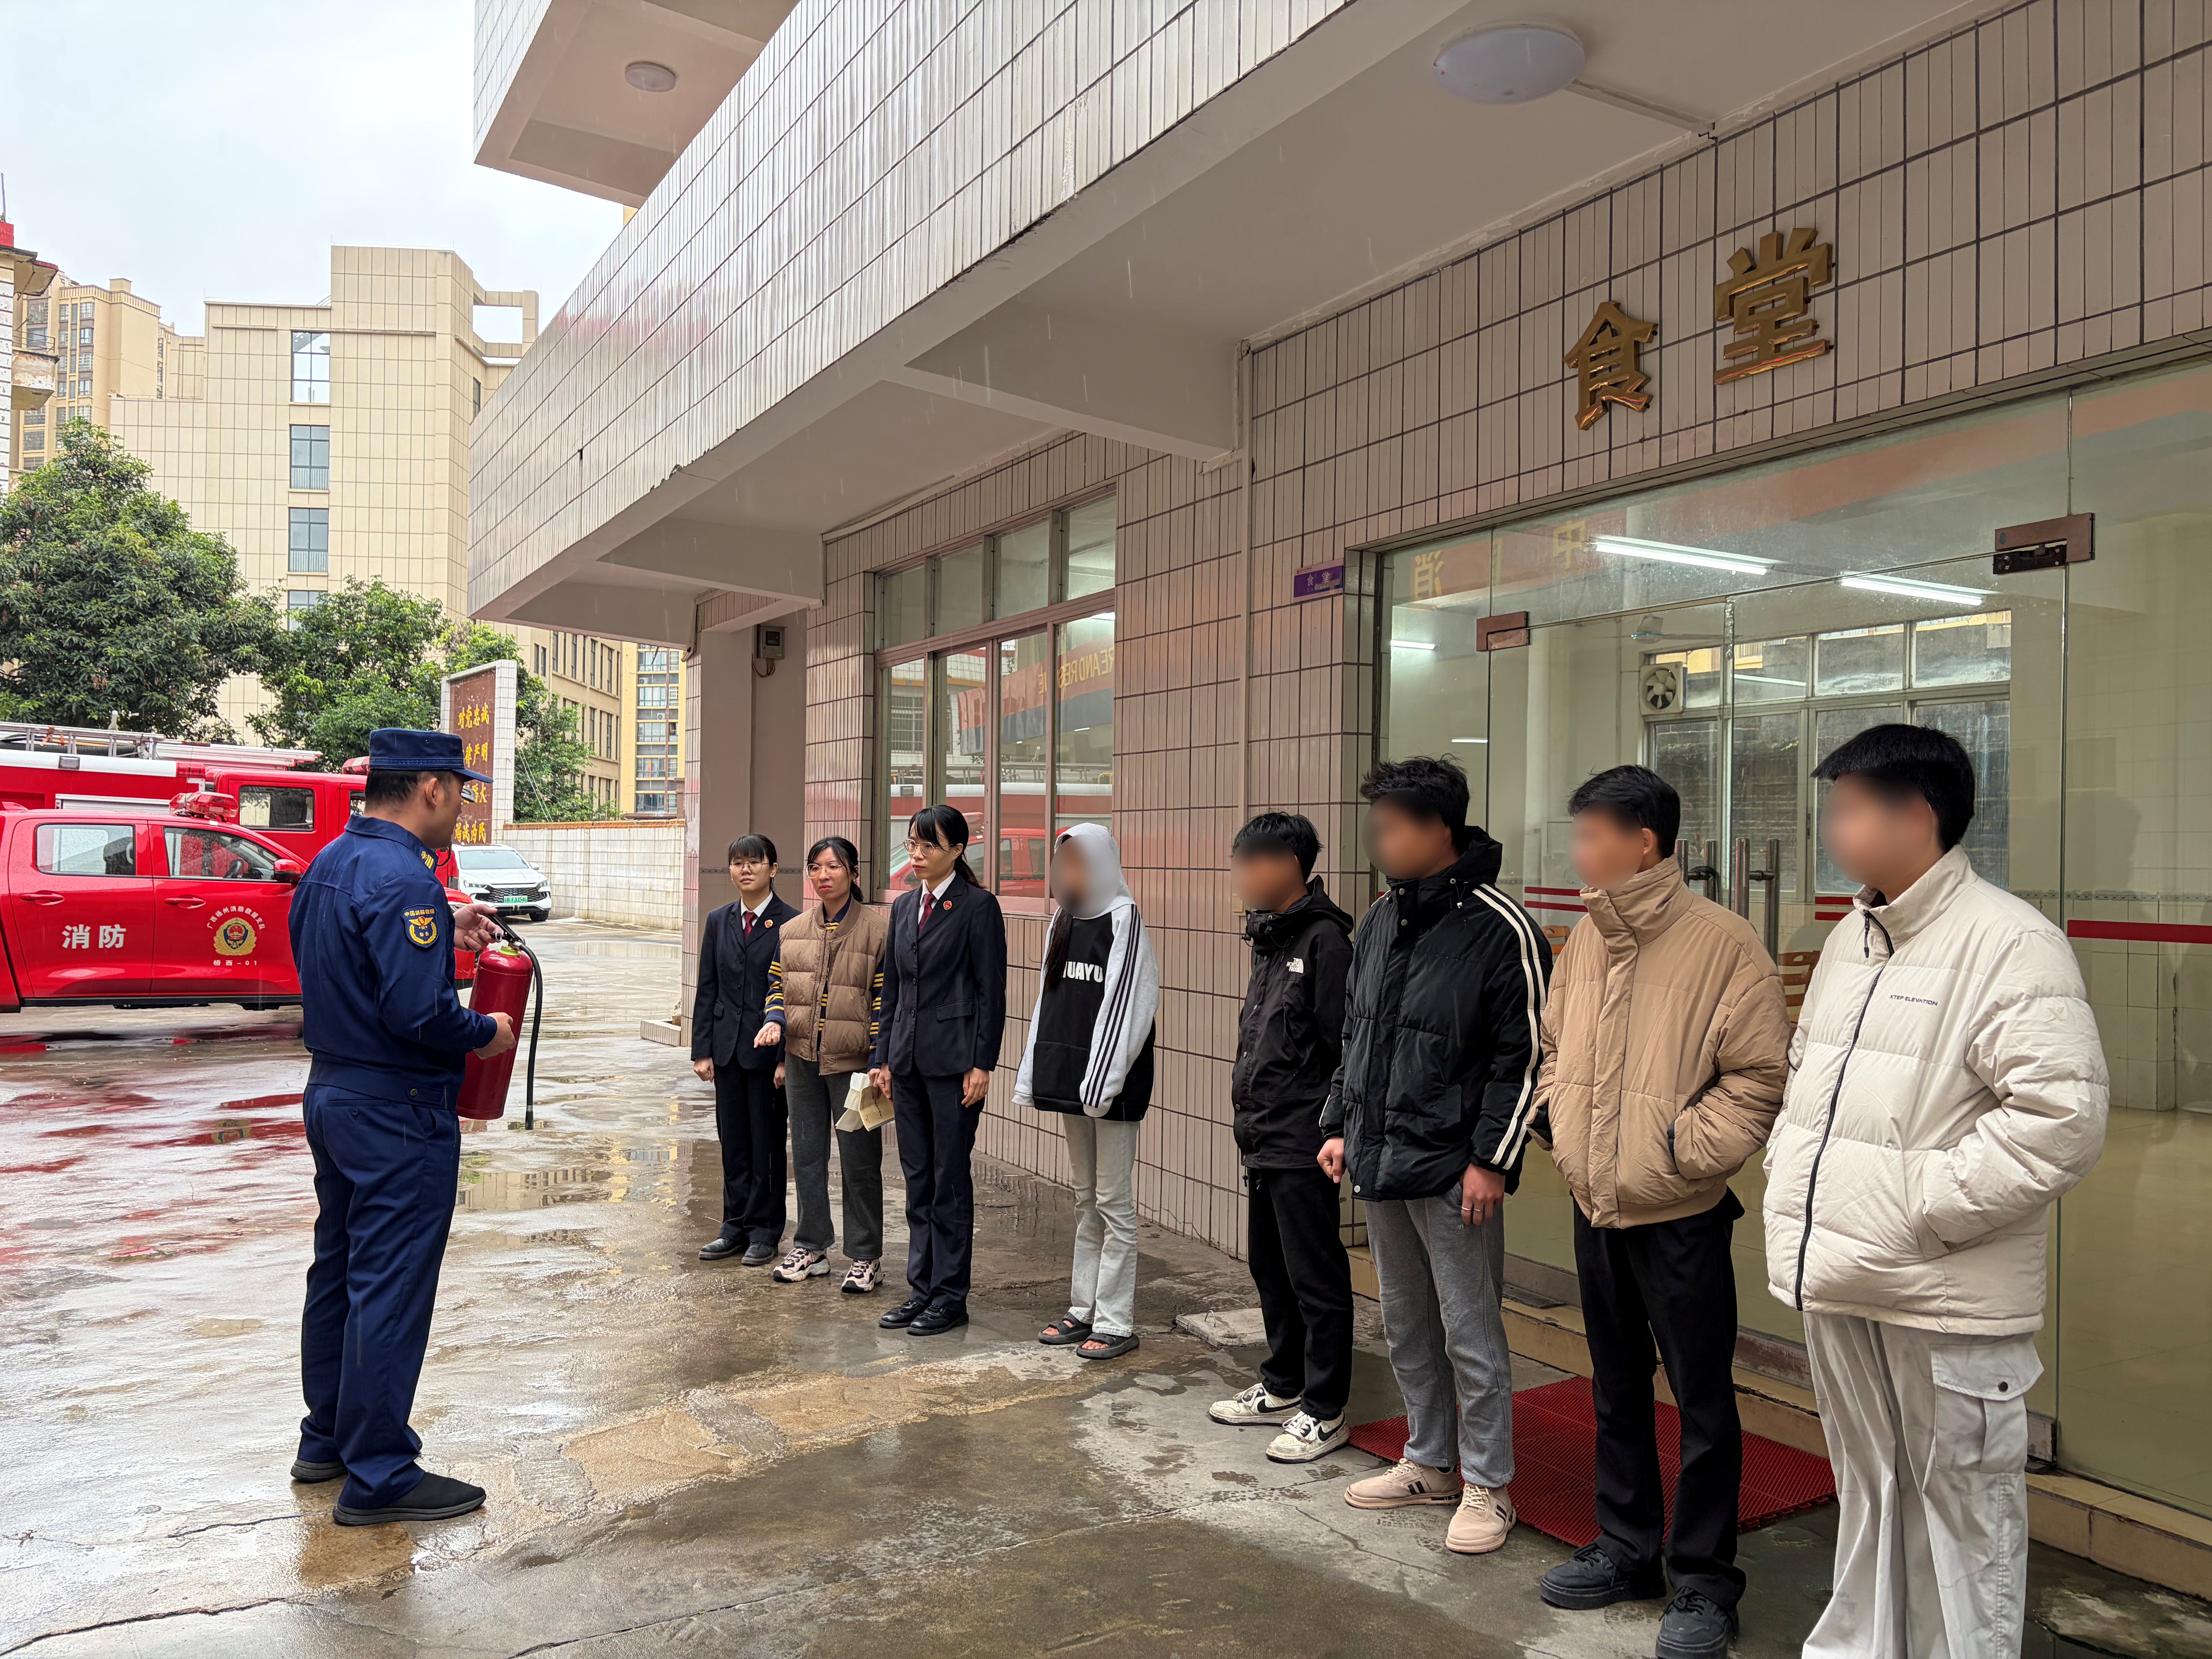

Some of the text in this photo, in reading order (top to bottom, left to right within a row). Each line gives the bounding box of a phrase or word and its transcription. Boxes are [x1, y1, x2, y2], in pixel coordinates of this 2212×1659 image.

[1563, 227, 1832, 431] 食堂
[1307, 571, 1330, 586] 食堂
[458, 702, 489, 729] 对党忠诚
[462, 742, 488, 768] 律严明
[455, 820, 486, 844] 竭诚为民
[62, 924, 127, 949] 消防
[1905, 997, 1938, 1006] ELEVATION
